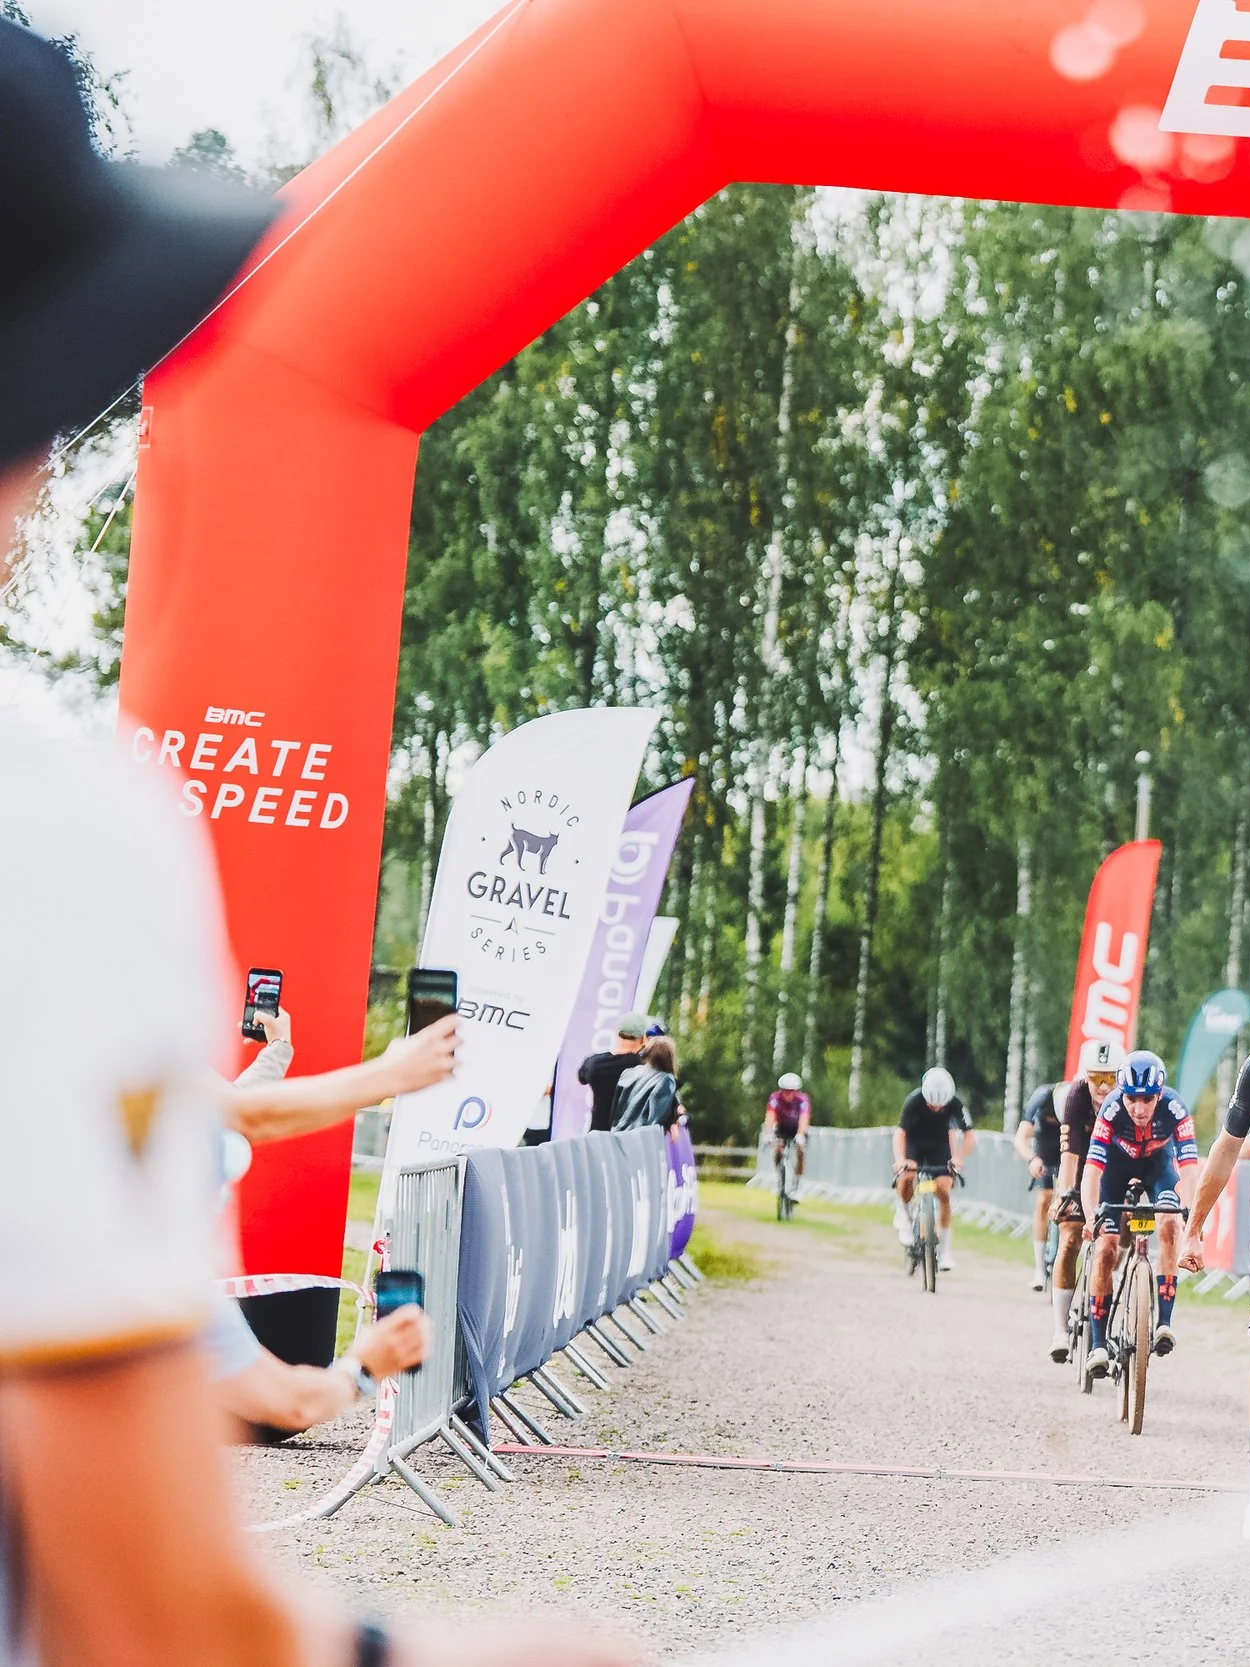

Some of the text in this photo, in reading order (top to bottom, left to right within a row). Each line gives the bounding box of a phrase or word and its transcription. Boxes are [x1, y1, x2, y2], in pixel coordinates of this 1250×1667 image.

[204, 706, 265, 727] BMC
[132, 727, 333, 780] CREATE
[177, 779, 349, 829] SPEED
[500, 790, 579, 827] NORDIC
[467, 871, 570, 920] GRAVEL
[471, 927, 546, 962] SERIES
[457, 998, 530, 1030] BMC
